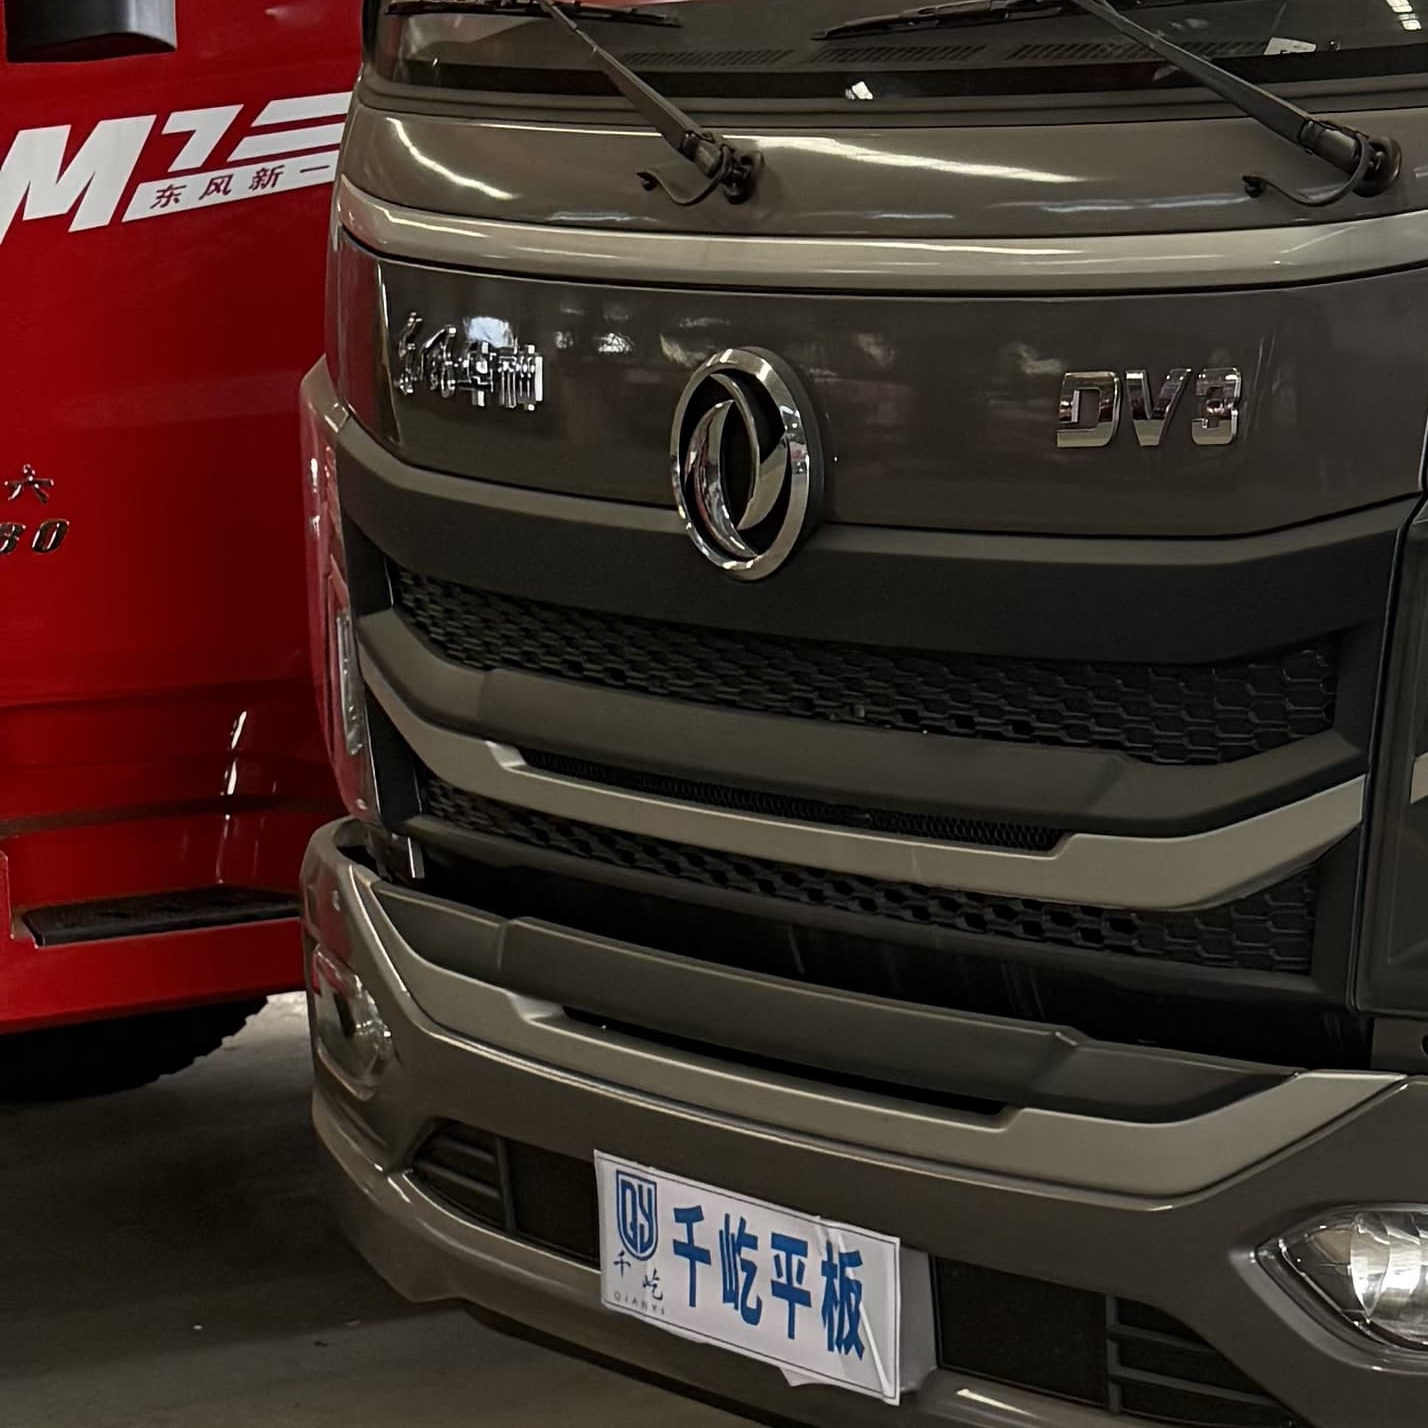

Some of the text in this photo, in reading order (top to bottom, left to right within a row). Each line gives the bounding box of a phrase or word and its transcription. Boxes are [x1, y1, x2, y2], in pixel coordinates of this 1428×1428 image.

[1056, 368, 1243, 448] DV3
[672, 1204, 865, 1361] 千屹平板
